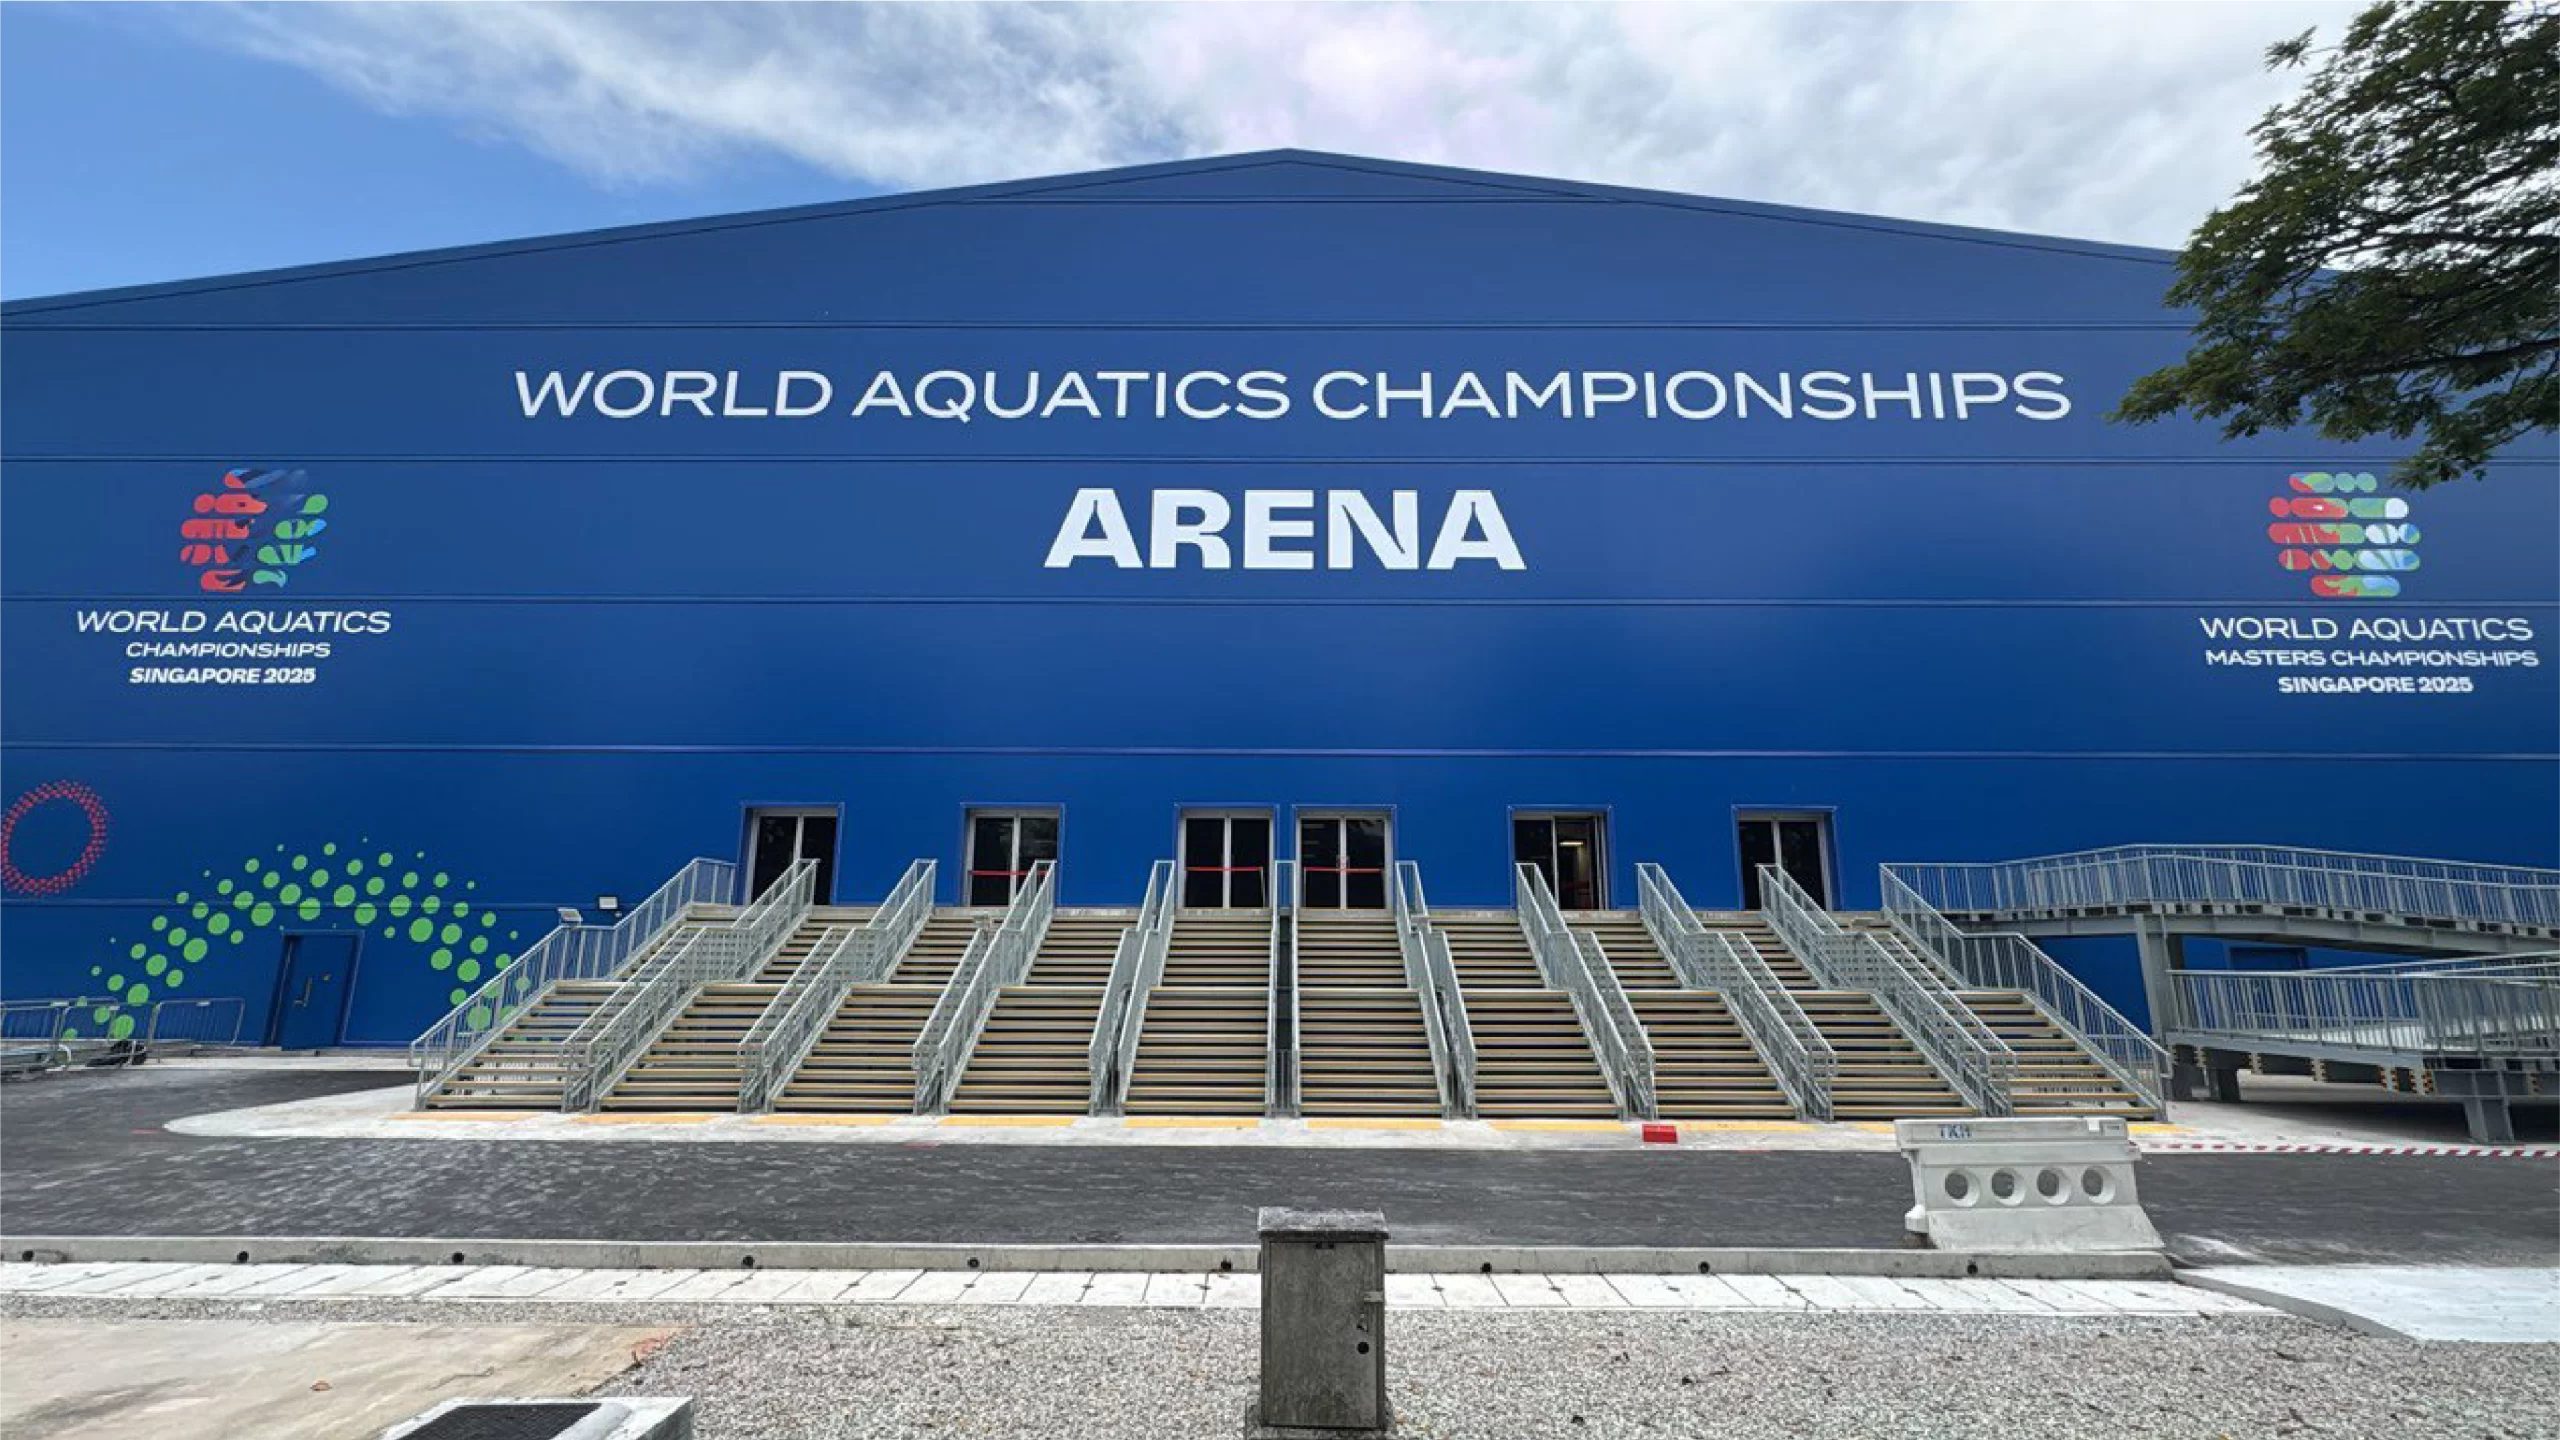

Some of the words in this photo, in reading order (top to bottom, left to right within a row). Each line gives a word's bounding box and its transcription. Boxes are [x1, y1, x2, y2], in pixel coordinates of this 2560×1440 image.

[515, 370, 833, 419] WORLD
[851, 370, 1290, 423] AQUATICS
[1312, 370, 2072, 421] CHAMPIONSHIPS
[1044, 487, 1527, 570] ARENA
[77, 610, 207, 633] WORLD
[213, 610, 391, 635] AQUATICS
[2199, 617, 2339, 640] WORLD
[2349, 617, 2534, 643] AQUATICS
[125, 641, 331, 659] CHAMPIONSHIPS
[2205, 649, 2327, 667] MASTERS
[2331, 649, 2540, 667] CHAMPIONSHIPS
[129, 667, 262, 684] SINGAPORE
[263, 667, 317, 684] 2025
[2278, 676, 2416, 694] SINGAPORE
[2418, 676, 2474, 693] 2025
